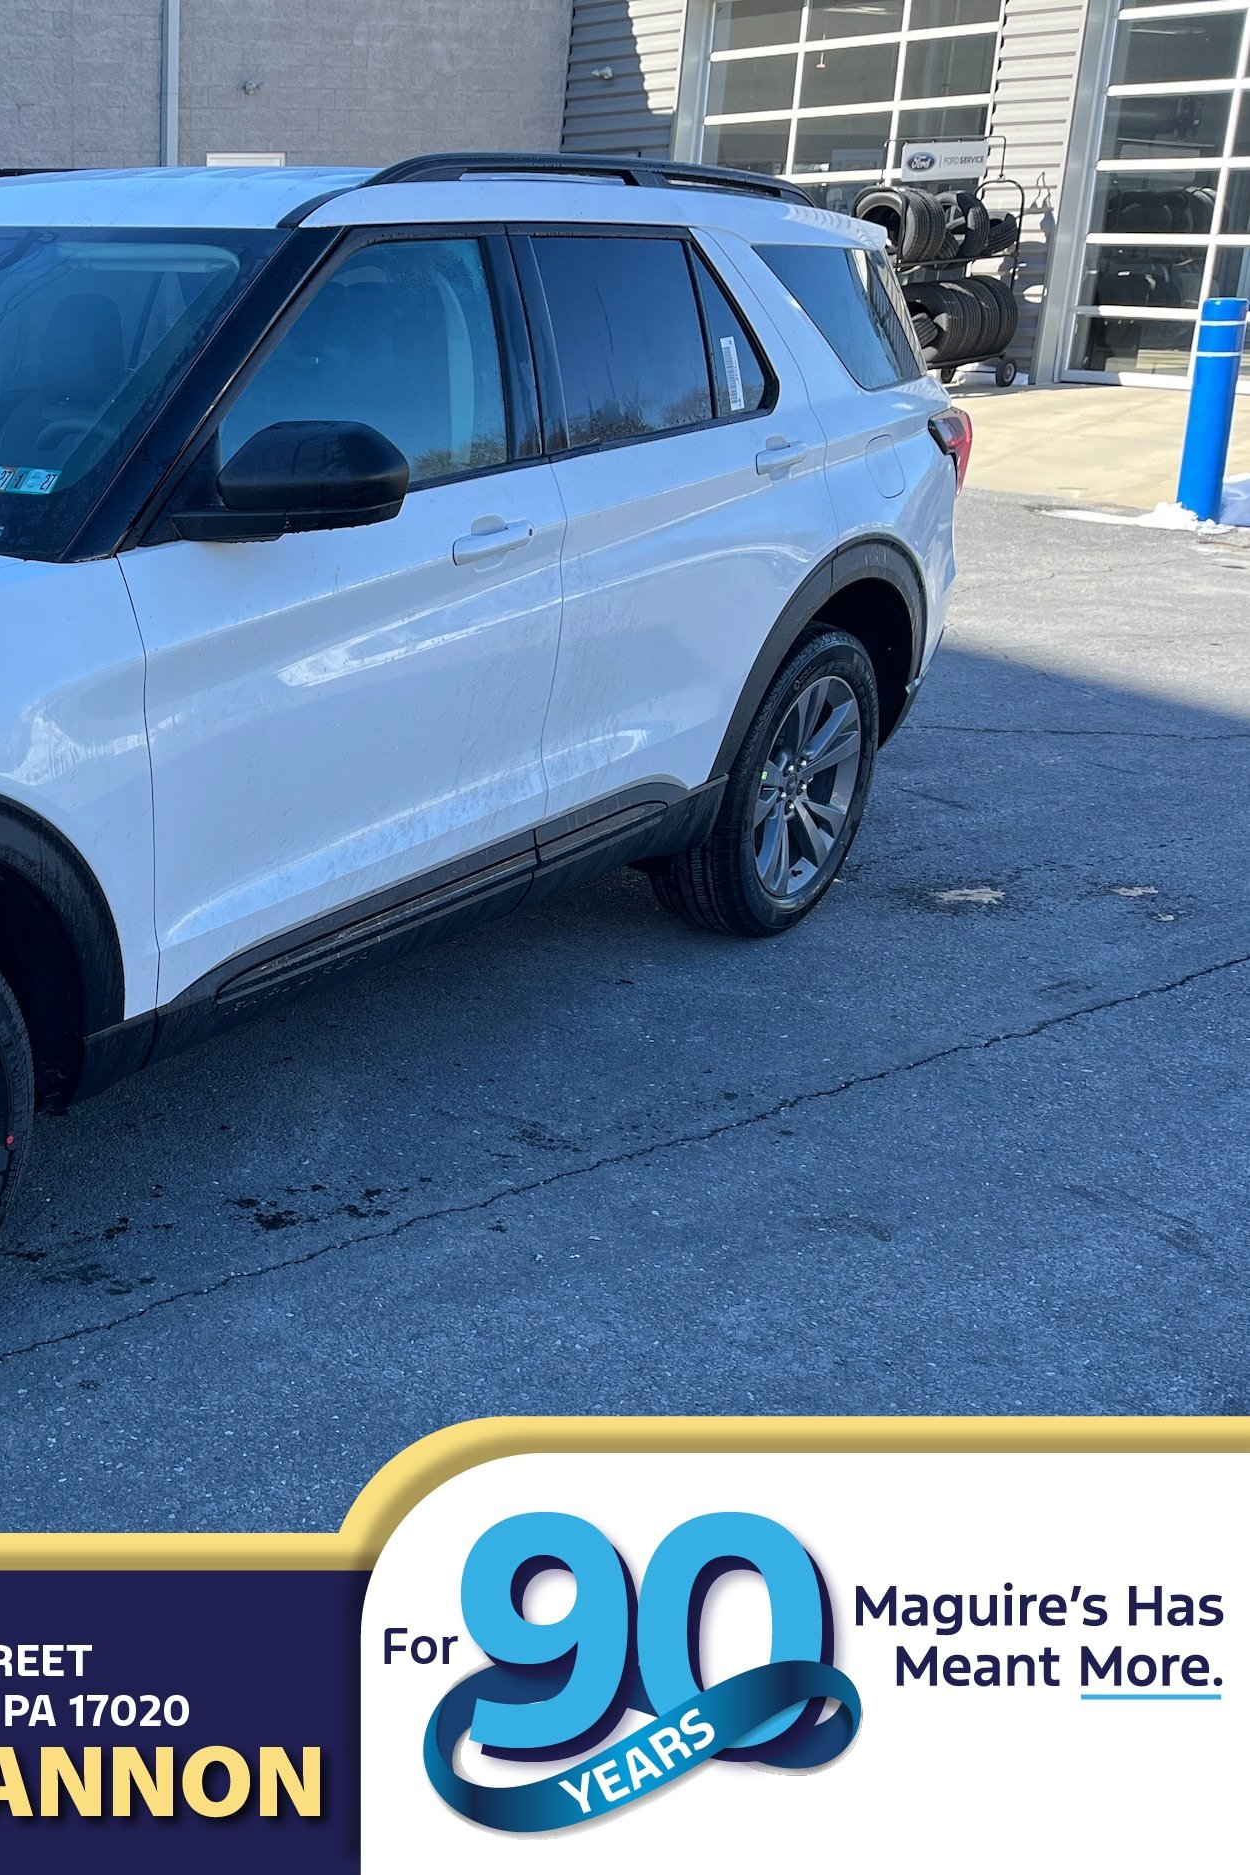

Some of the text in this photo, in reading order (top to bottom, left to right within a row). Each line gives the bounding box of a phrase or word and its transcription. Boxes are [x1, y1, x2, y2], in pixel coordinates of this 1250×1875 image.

[911, 155, 984, 169] Ford FORD SERVICE
[40, 473, 57, 492] 27
